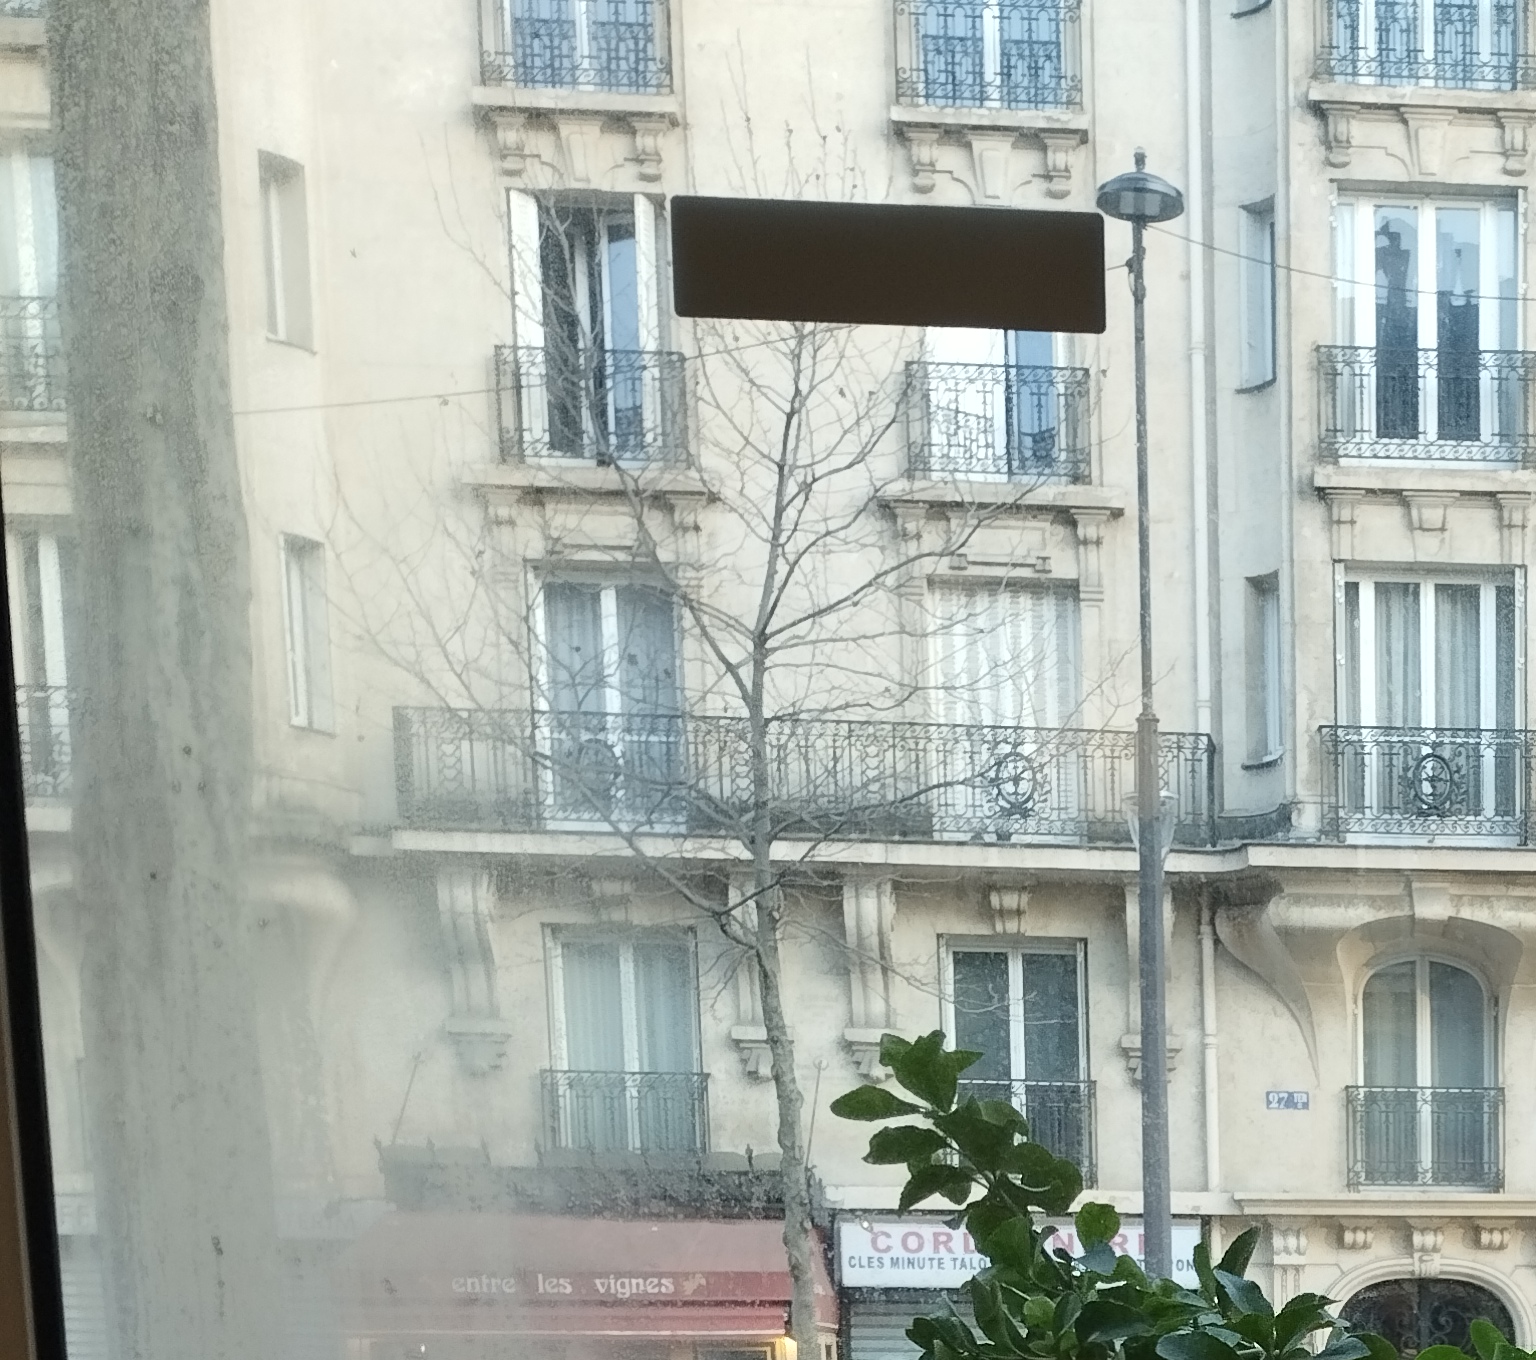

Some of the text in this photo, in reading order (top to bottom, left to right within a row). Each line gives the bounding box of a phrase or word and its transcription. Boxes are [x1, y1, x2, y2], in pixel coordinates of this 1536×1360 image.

[1268, 1092, 1289, 1109] 27
[847, 1255, 988, 1271] CLES MINUTE TALO
[451, 1273, 675, 1299] entre les vignes
